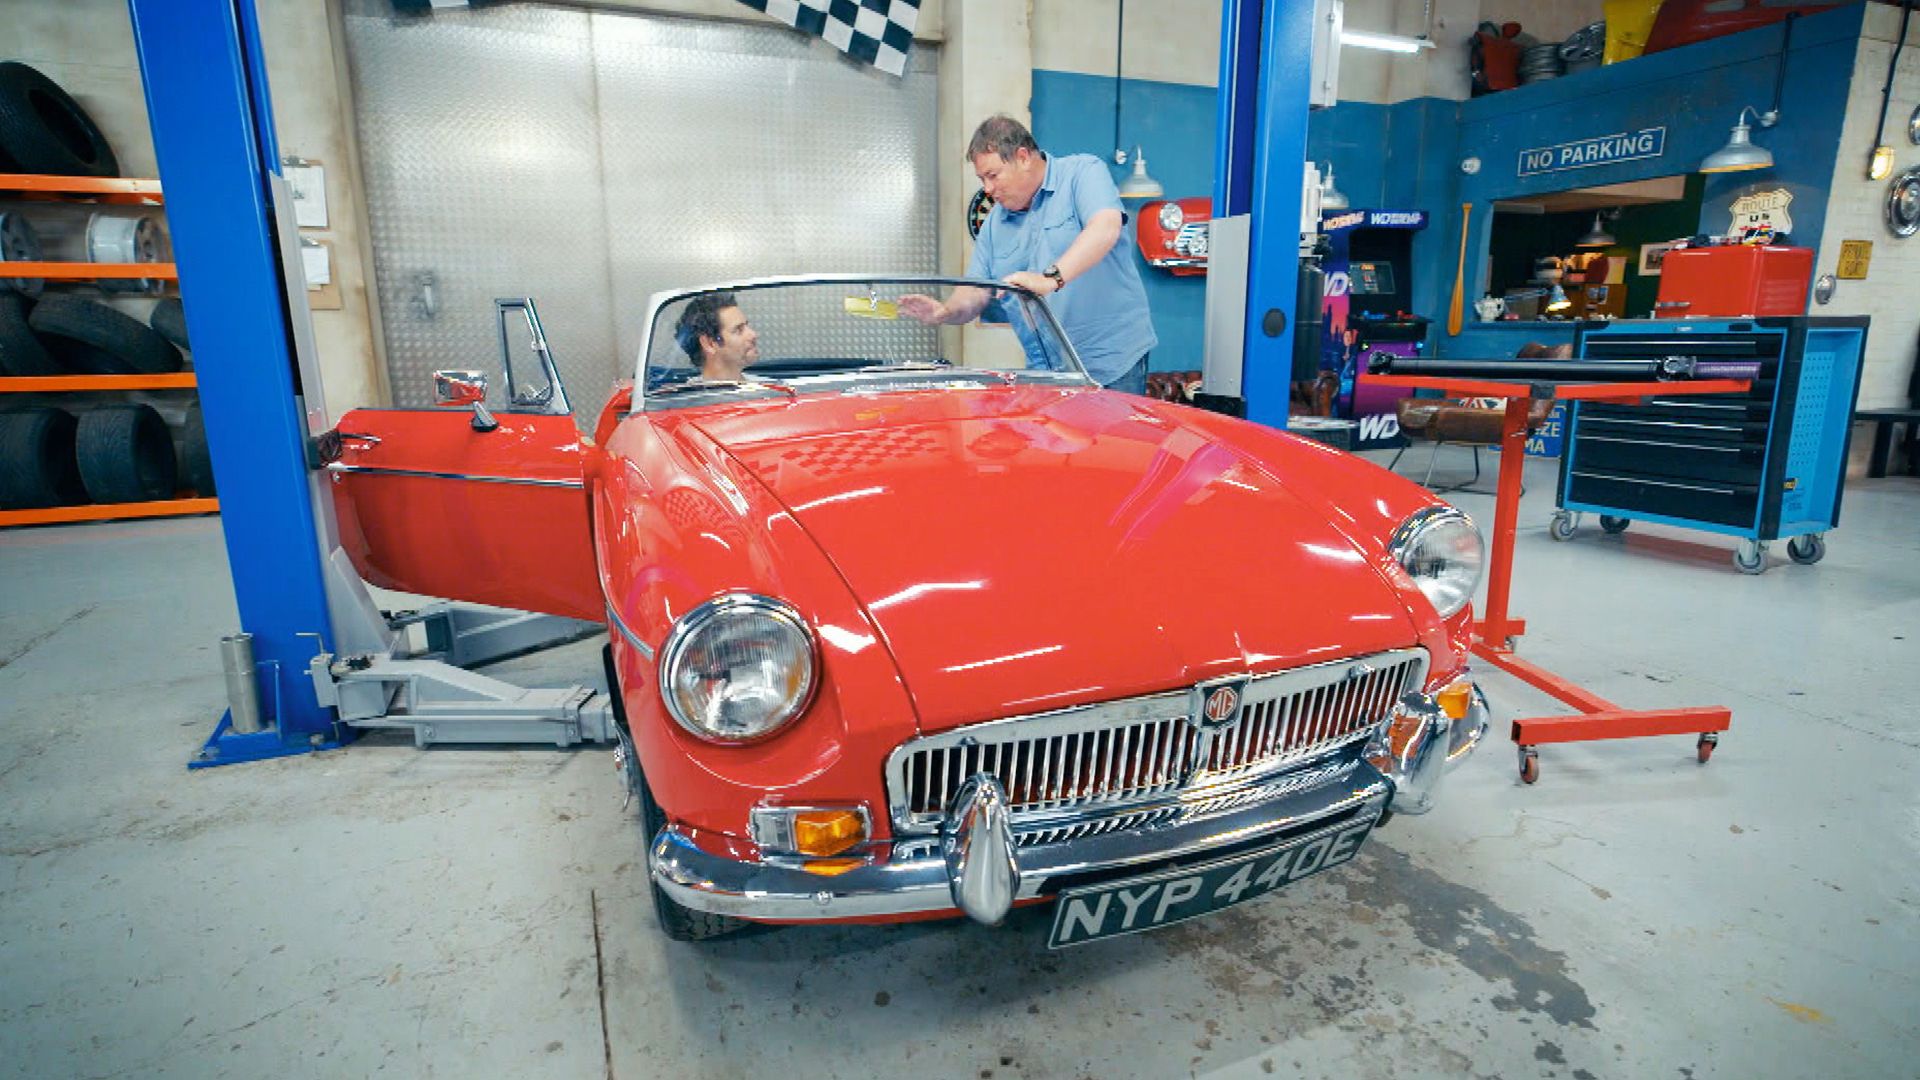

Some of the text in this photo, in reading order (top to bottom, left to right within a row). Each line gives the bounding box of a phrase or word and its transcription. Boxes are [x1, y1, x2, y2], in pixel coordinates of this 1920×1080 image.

[1527, 134, 1654, 170] NO PARKING
[1742, 196, 1778, 212] ROUTE
[1359, 413, 1400, 441] WD
[1208, 689, 1235, 720] MG
[1059, 831, 1355, 942] NYP 440E
